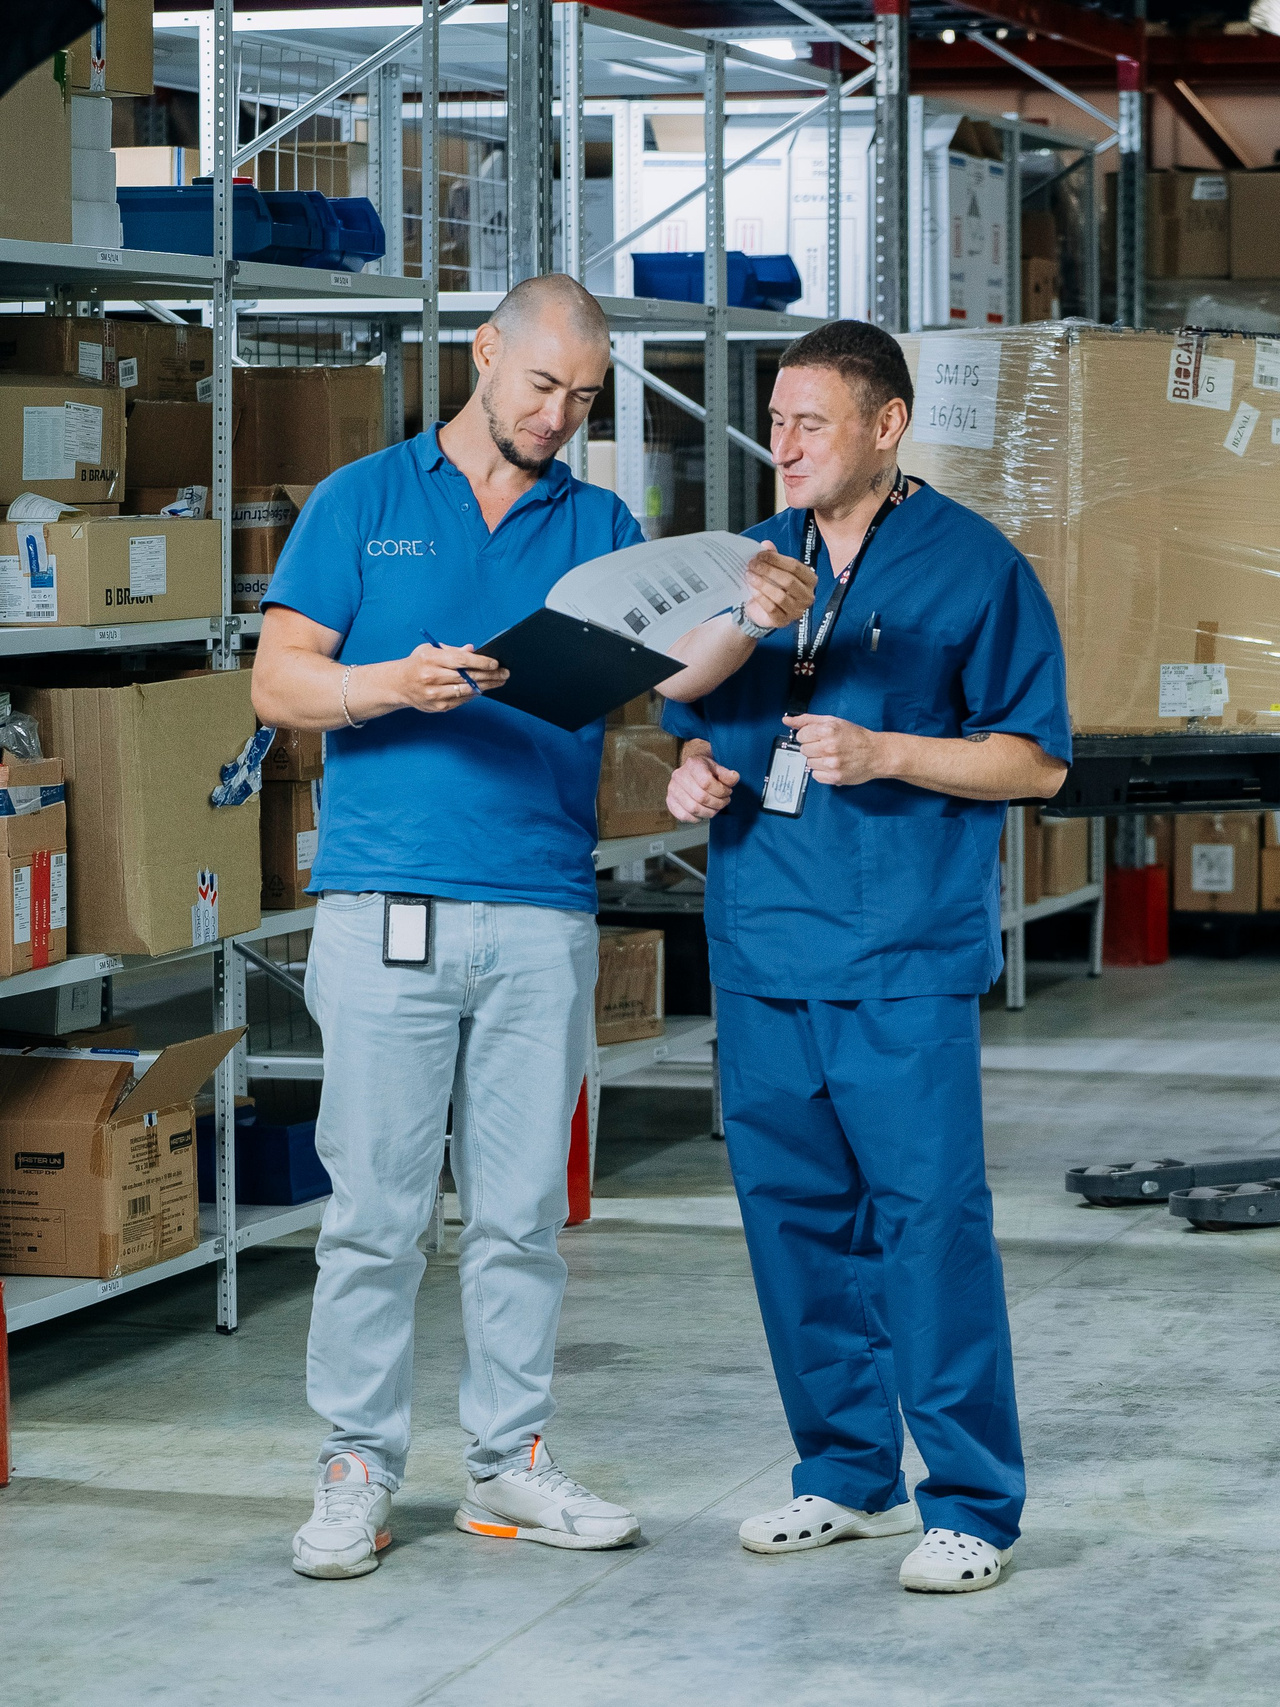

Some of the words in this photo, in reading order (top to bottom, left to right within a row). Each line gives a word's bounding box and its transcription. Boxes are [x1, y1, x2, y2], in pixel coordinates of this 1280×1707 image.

[935, 363, 959, 386] SM
[963, 365, 980, 387] PS
[929, 404, 978, 432] 16/3/1
[1231, 414, 1251, 449] BEZNAL
[367, 539, 437, 557] COREX
